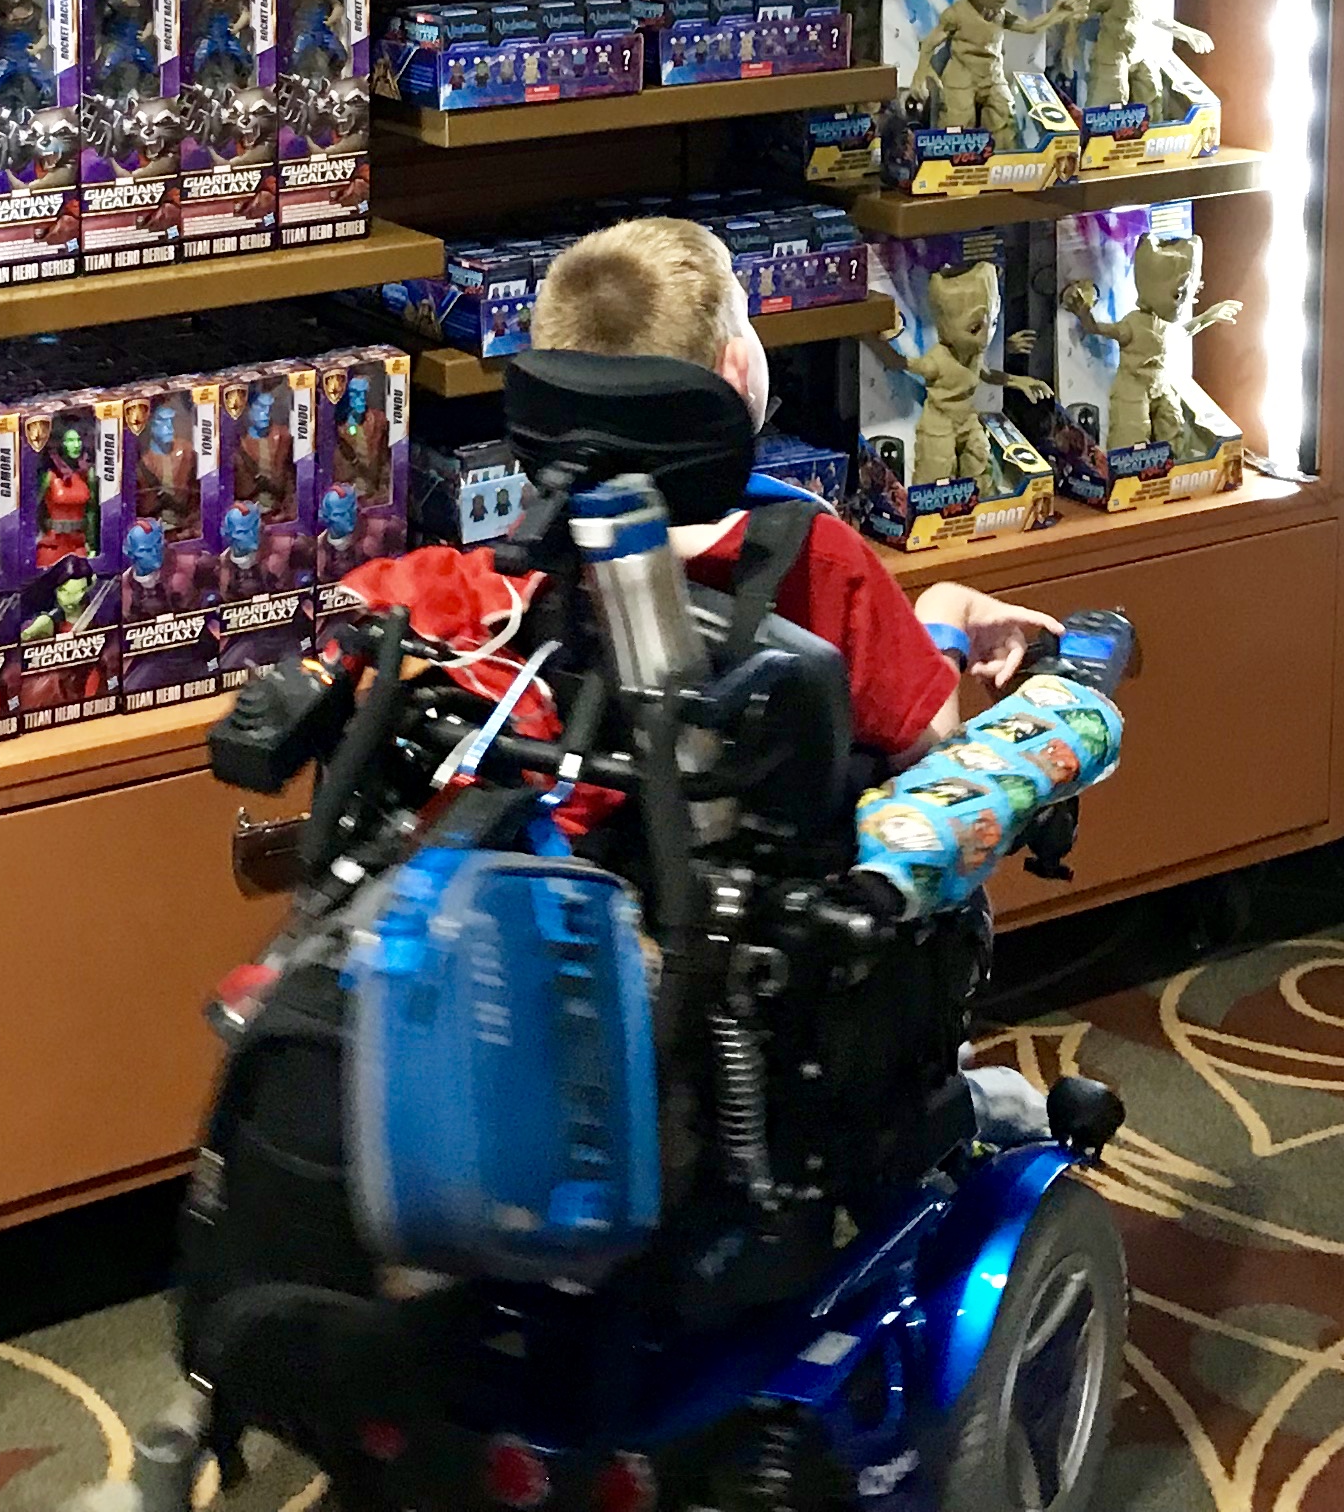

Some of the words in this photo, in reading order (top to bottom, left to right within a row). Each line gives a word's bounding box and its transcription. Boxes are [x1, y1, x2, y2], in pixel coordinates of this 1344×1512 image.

[183, 170, 262, 188] GUARDIANS
[281, 158, 356, 177] GUARDIANS
[297, 167, 354, 185] GALAXY
[990, 162, 1046, 186] GROOT
[84, 182, 165, 201] GUARDIANS
[199, 180, 260, 197] GALAXY
[101, 192, 163, 210] GALAXY
[183, 240, 211, 257] TITAN
[213, 237, 238, 254] HERO
[240, 232, 272, 250] SERIES
[281, 227, 308, 245] TITAN
[310, 224, 333, 240] HERO
[335, 220, 365, 237] SERIES
[84, 254, 112, 271] TITAN
[115, 250, 140, 267] HERO
[143, 245, 175, 264] SERIES
[12, 263, 38, 282] HERO
[41, 259, 75, 278] SERIES
[393, 389, 404, 425] YONDU
[297, 403, 309, 440] YONDU
[202, 419, 213, 456] YONDU
[104, 433, 115, 482] GAMORA
[0, 447, 12, 498] GAMORA
[976, 506, 1026, 531] GROOT
[222, 596, 299, 620] GUARDIANS
[238, 605, 297, 627] GALAXY
[125, 615, 205, 640] GUARDIANS
[142, 624, 202, 648] GALAXY
[24, 633, 106, 659] GUARDIANS
[41, 643, 103, 666] GALAXY
[222, 668, 249, 688] TITAN
[126, 690, 153, 710] TITAN
[156, 684, 181, 704] HERO
[183, 677, 216, 698] SERIES
[24, 709, 52, 729] TITAN
[55, 704, 80, 723] HERO
[83, 696, 116, 717] SERIES
